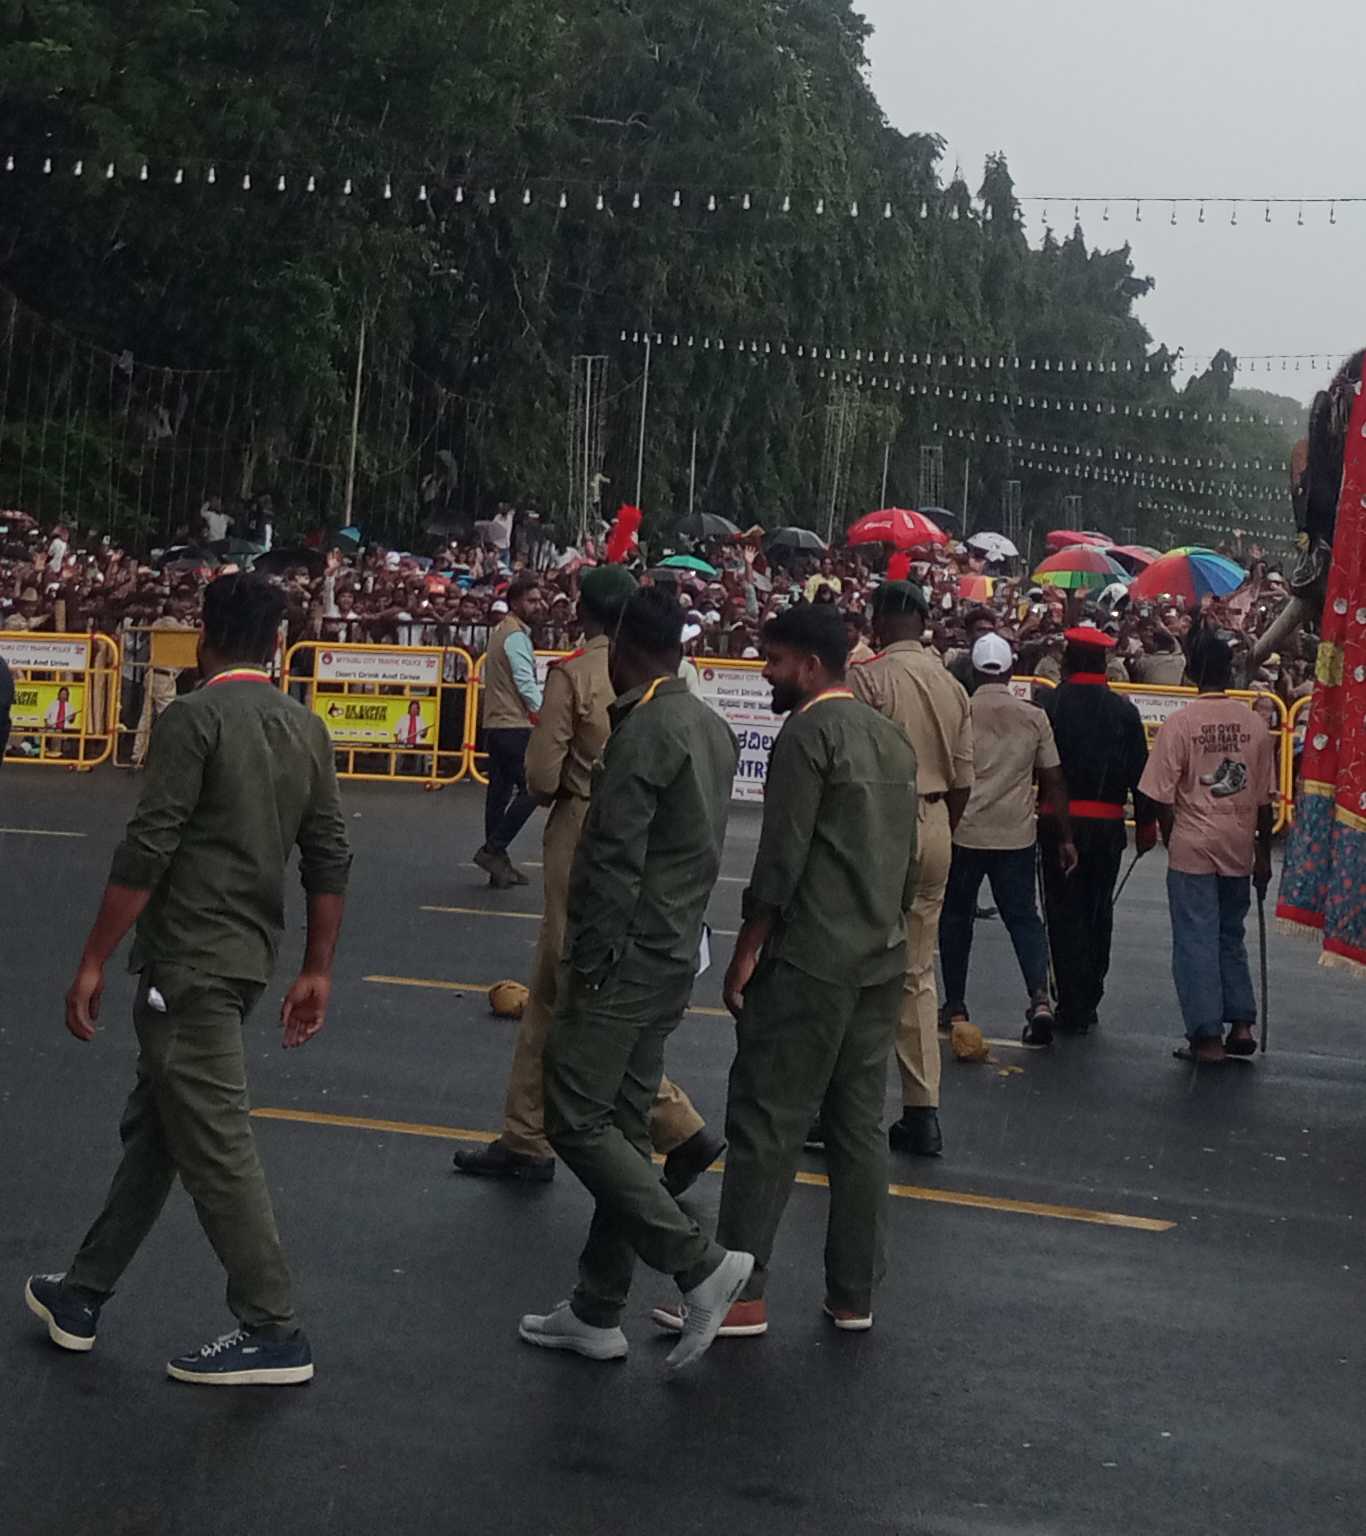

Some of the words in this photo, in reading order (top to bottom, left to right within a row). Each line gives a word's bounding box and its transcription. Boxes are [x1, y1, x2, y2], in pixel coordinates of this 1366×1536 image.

[1201, 724, 1216, 734] GET
[1217, 723, 1241, 733] OVER
[1191, 734, 1216, 745] YOUR
[1240, 733, 1251, 744] OF
